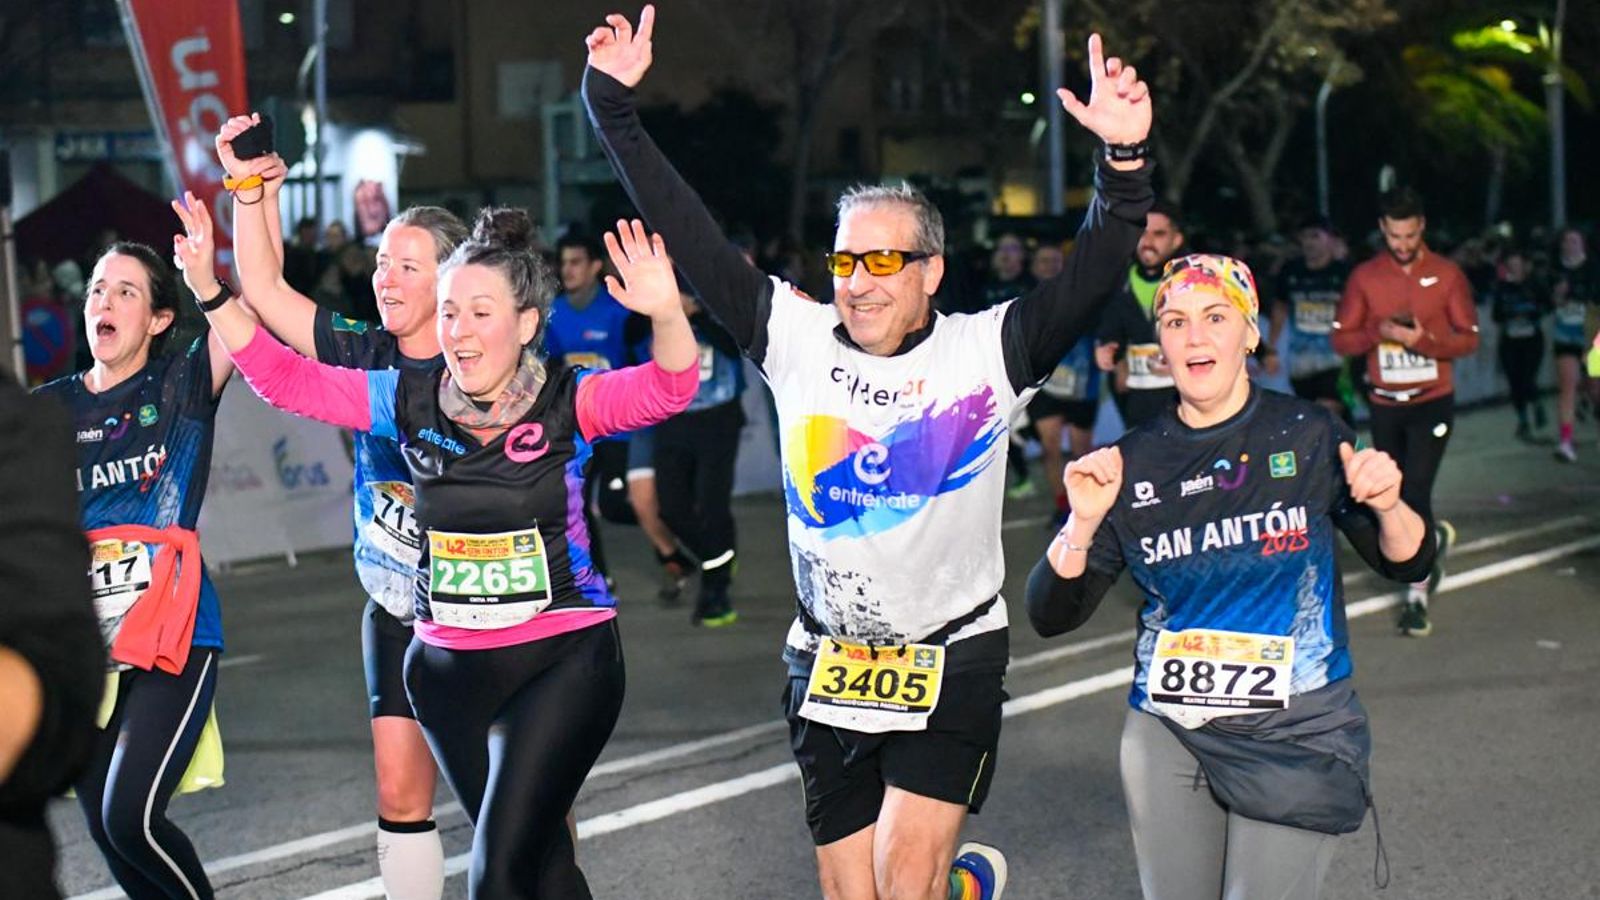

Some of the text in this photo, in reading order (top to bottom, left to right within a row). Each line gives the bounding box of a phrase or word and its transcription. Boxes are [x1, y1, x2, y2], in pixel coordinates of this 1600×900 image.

[1140, 501, 1308, 565] SAN ANTÓN
[1259, 530, 1310, 556] 2025
[436, 556, 537, 595] 2265
[822, 666, 928, 703] 3405
[1161, 659, 1277, 697] 8872
